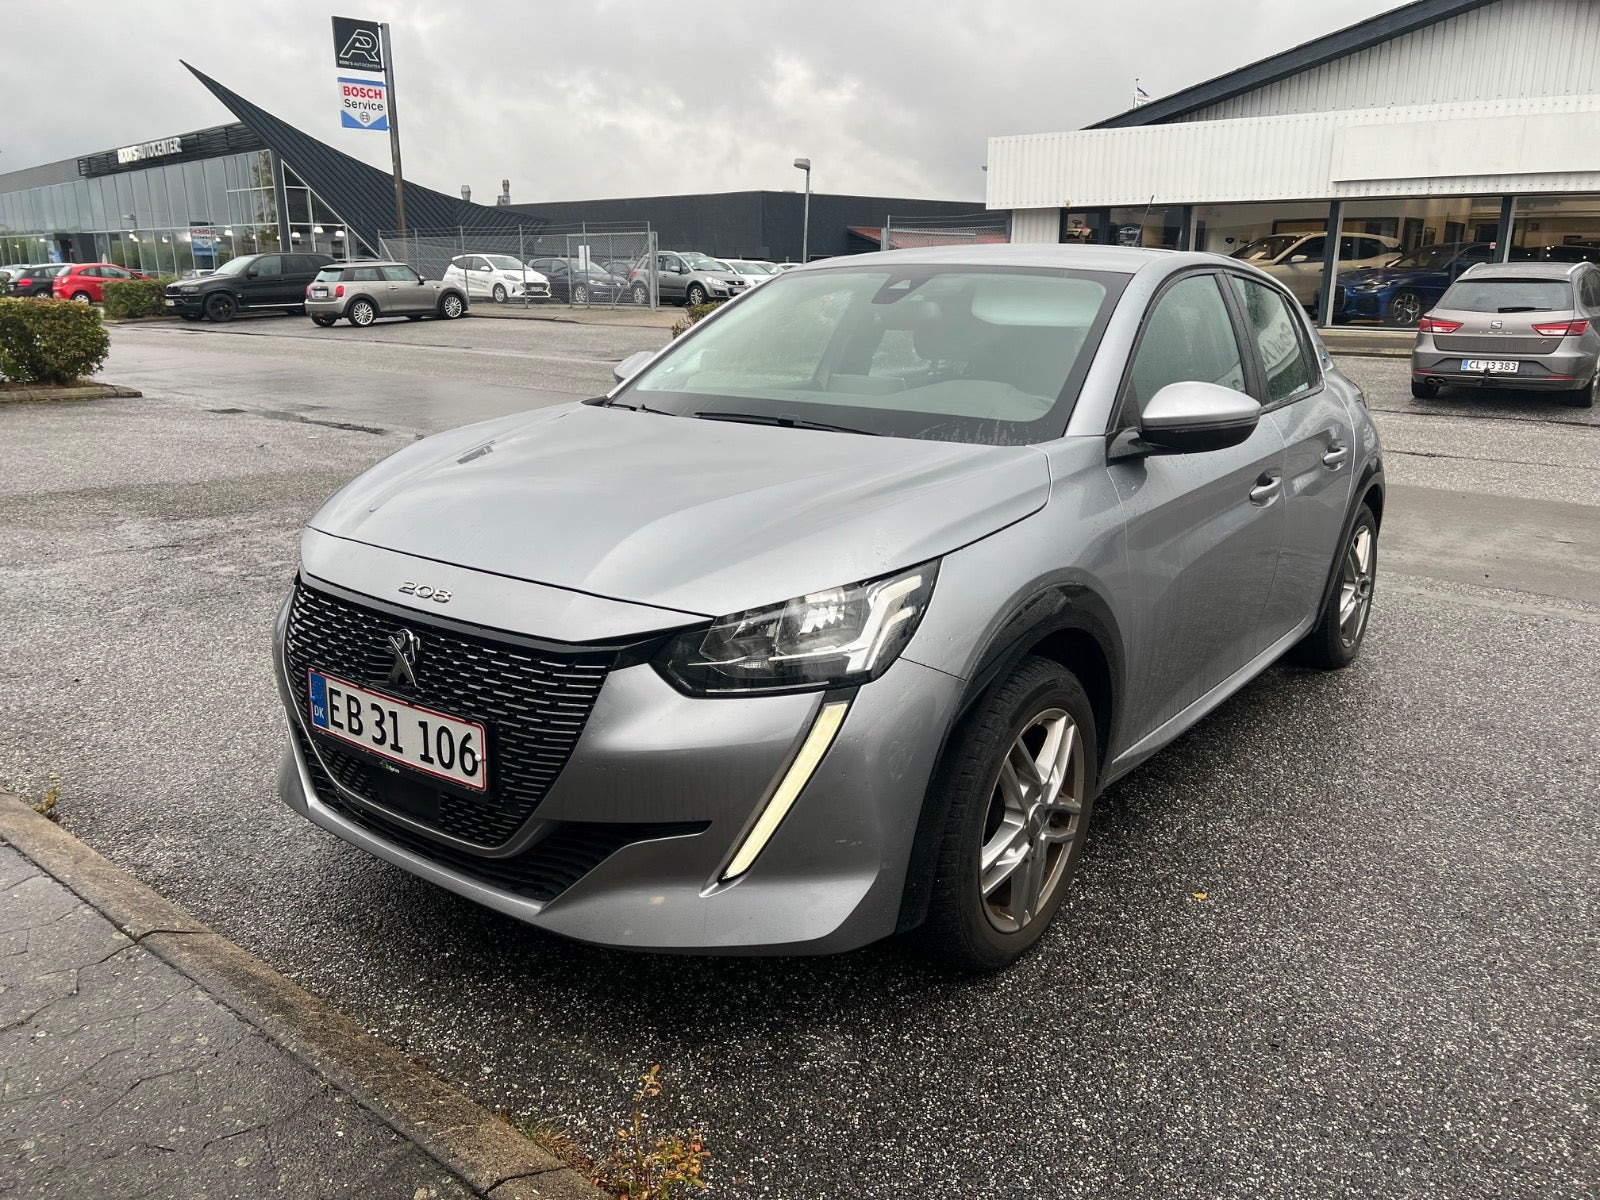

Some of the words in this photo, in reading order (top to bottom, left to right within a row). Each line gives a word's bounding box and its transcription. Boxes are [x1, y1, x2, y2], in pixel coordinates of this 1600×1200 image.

[343, 86, 382, 99] BOSCH
[344, 99, 383, 111] Service
[1469, 361, 1481, 369] CL
[1485, 362, 1496, 370] 13
[1498, 362, 1517, 370] 383
[398, 581, 452, 604] 208
[314, 705, 324, 719] DK
[328, 687, 363, 736] EB
[371, 703, 404, 754] 31
[418, 720, 480, 777] 106
